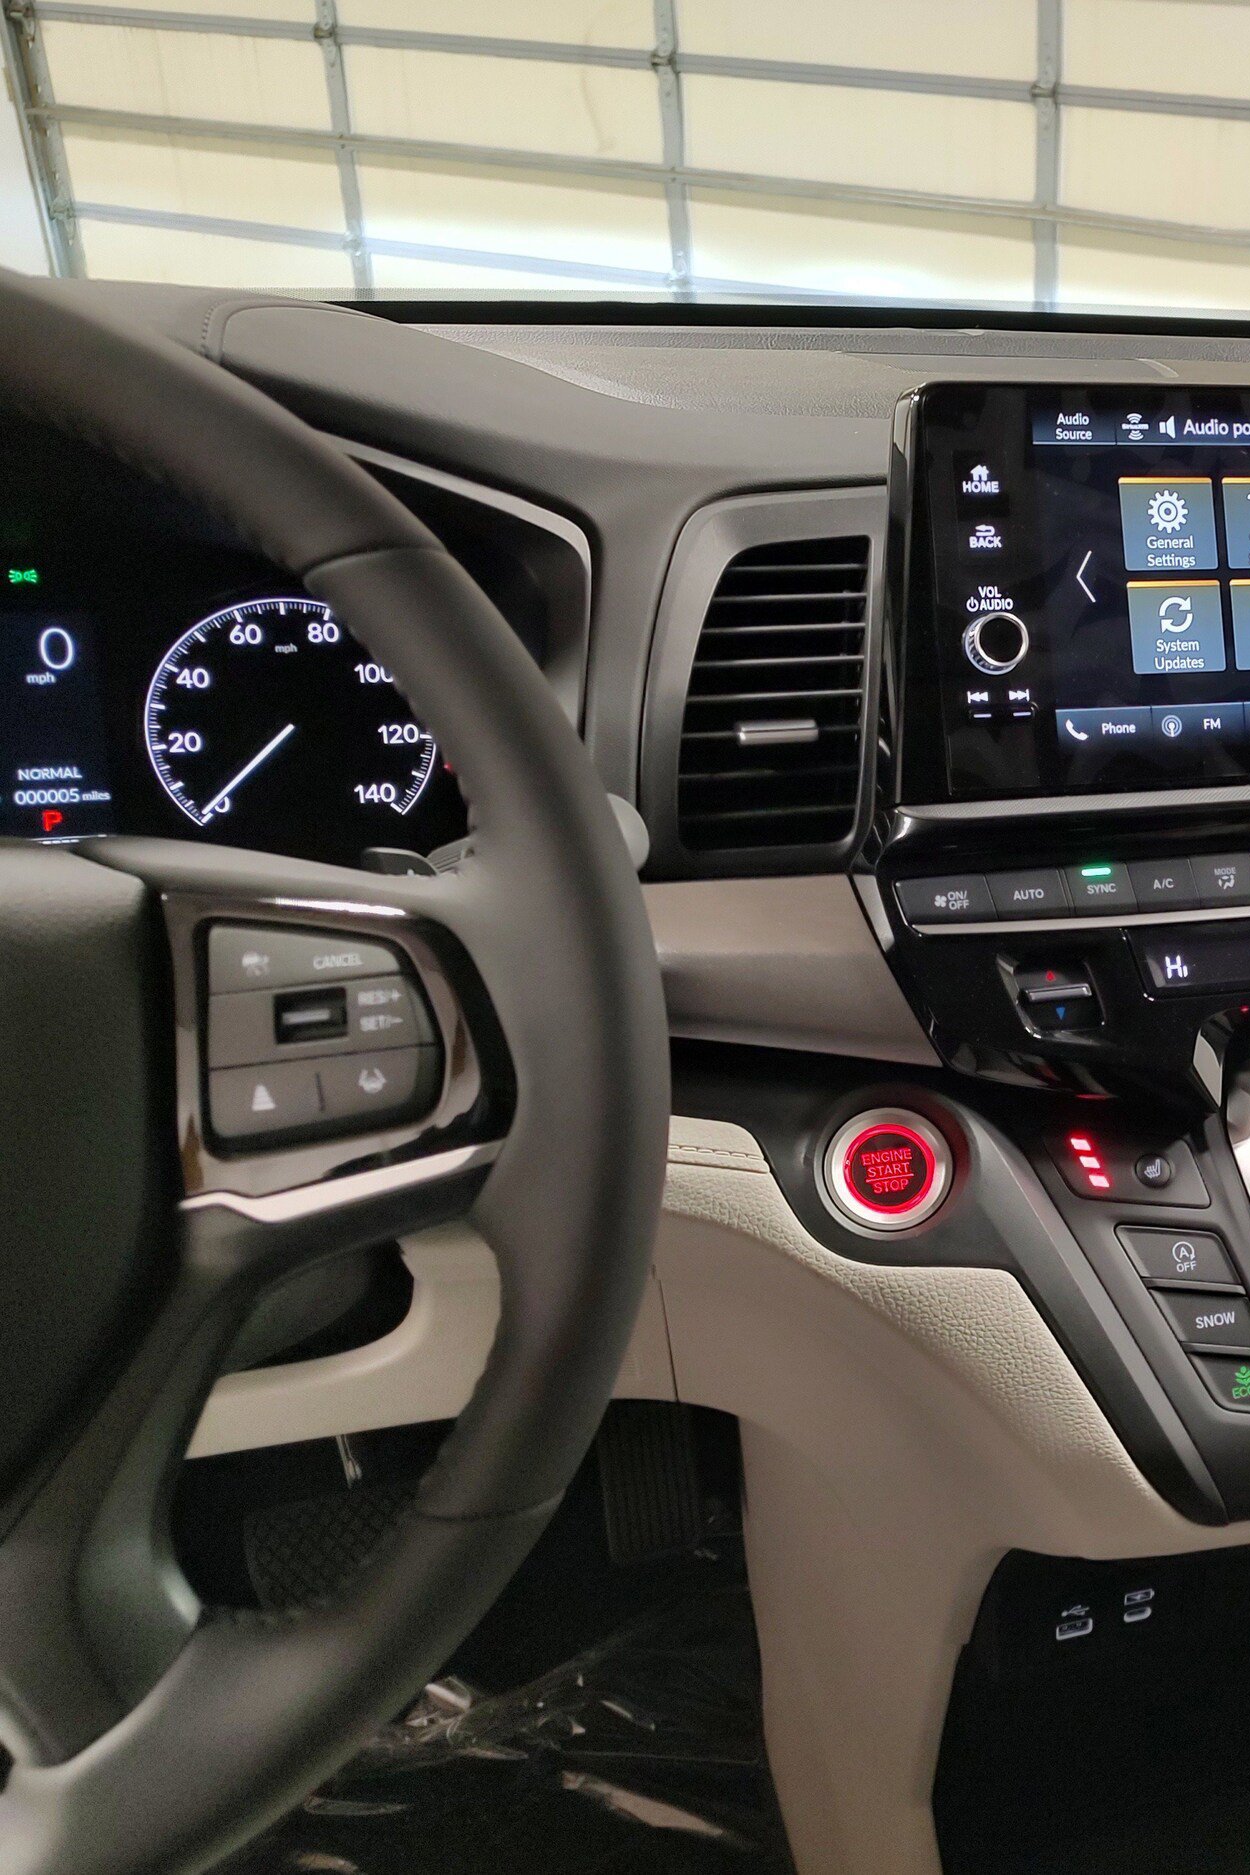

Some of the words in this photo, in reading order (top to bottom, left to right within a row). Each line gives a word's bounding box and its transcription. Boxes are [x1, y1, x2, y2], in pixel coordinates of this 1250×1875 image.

[1057, 412, 1090, 426] Audio
[1055, 428, 1093, 441] Source
[1183, 420, 1228, 436] Audio
[962, 480, 1000, 494] HOME
[968, 536, 1002, 549] BACK
[1146, 535, 1194, 550] General
[1147, 553, 1196, 569] Settings
[978, 586, 1002, 599] VOL
[980, 598, 1014, 611] AUDIO
[229, 623, 262, 645] 60
[307, 623, 340, 644] 80
[40, 626, 75, 670] 0
[274, 643, 299, 656] mph
[1156, 639, 1200, 654] System
[1154, 656, 1205, 672] Updates
[26, 672, 57, 687] mph
[176, 668, 211, 689] 40
[1101, 722, 1136, 735] Phone
[1203, 717, 1222, 731] FM
[377, 723, 419, 745] 120
[168, 732, 202, 753] 20
[18, 766, 83, 781] NORMAL
[14, 788, 80, 804] 000005
[82, 790, 111, 802] miles
[353, 782, 397, 804] 140
[42, 810, 63, 832] P
[1214, 866, 1237, 877] MODE
[1086, 882, 1117, 896] SYNC
[1153, 877, 1175, 891] A/C
[948, 890, 968, 902] ON/
[1013, 888, 1045, 901] AUTO
[949, 898, 970, 911] OFF
[312, 952, 364, 970] CANCEL
[861, 1147, 913, 1166] ENGINE
[867, 1161, 911, 1178] START
[873, 1178, 910, 1194] STOP
[1176, 1260, 1197, 1273] OFF
[1195, 1311, 1236, 1329] SNOW
